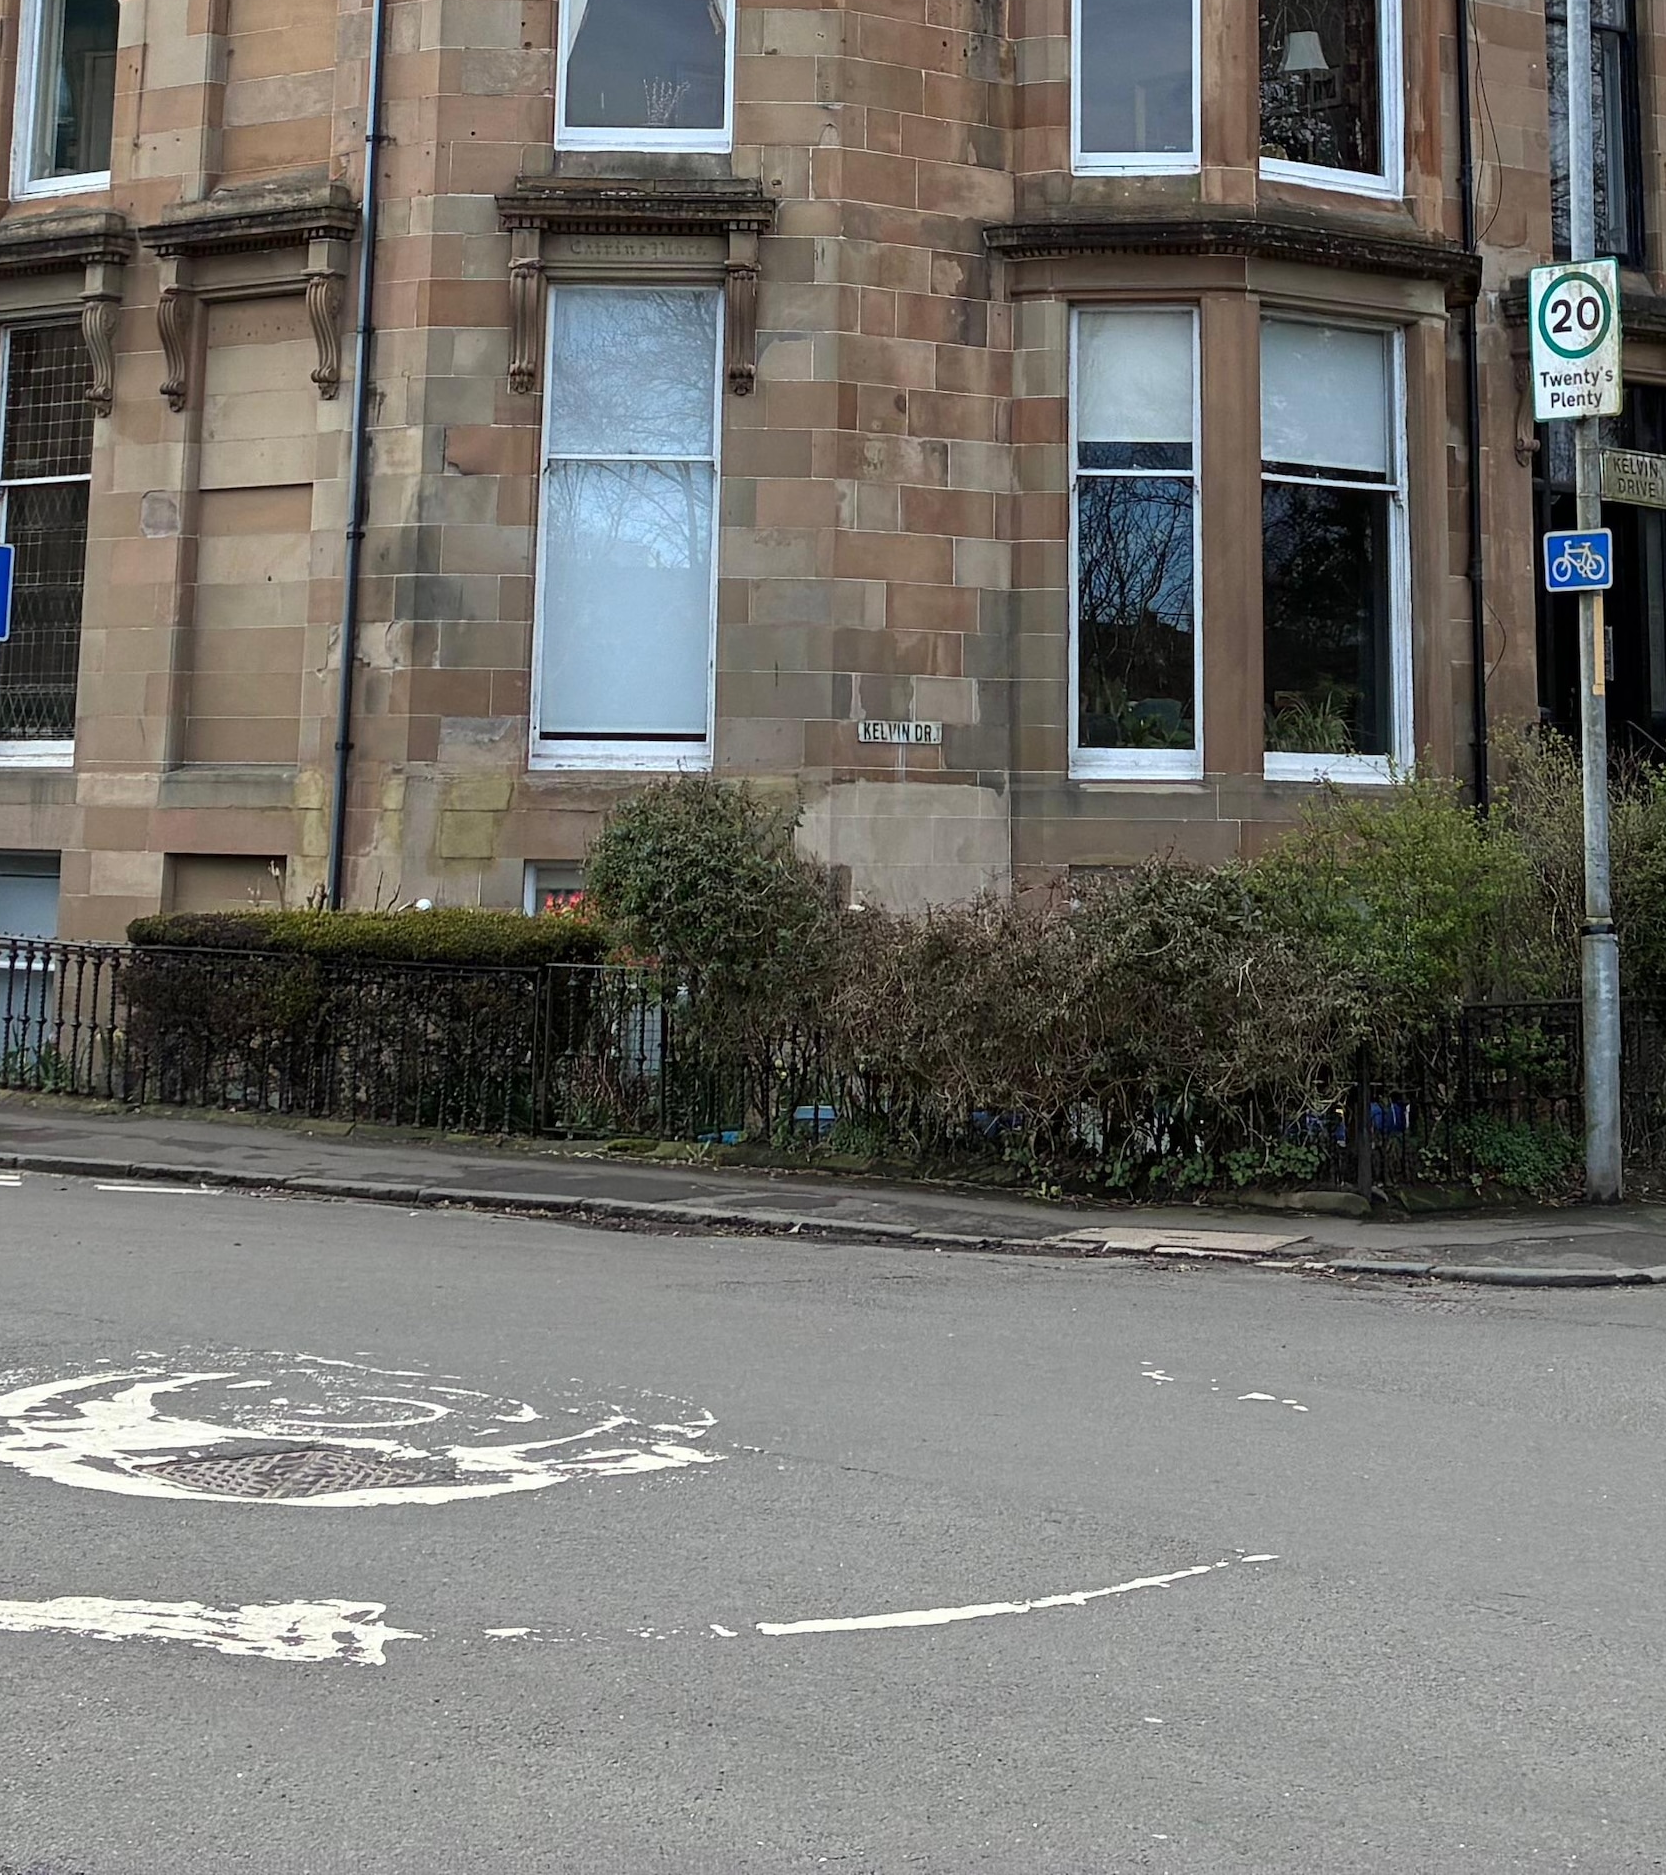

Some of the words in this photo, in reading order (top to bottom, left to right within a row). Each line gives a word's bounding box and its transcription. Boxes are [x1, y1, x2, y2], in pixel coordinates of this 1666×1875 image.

[1550, 295, 1601, 334] 20
[1539, 366, 1614, 388] Twenty's
[1550, 390, 1603, 409] Plenty
[1613, 456, 1659, 478] KELVIN
[1618, 477, 1656, 498] DRIVE
[863, 722, 910, 742] KELVIN
[915, 723, 937, 743] DR.
